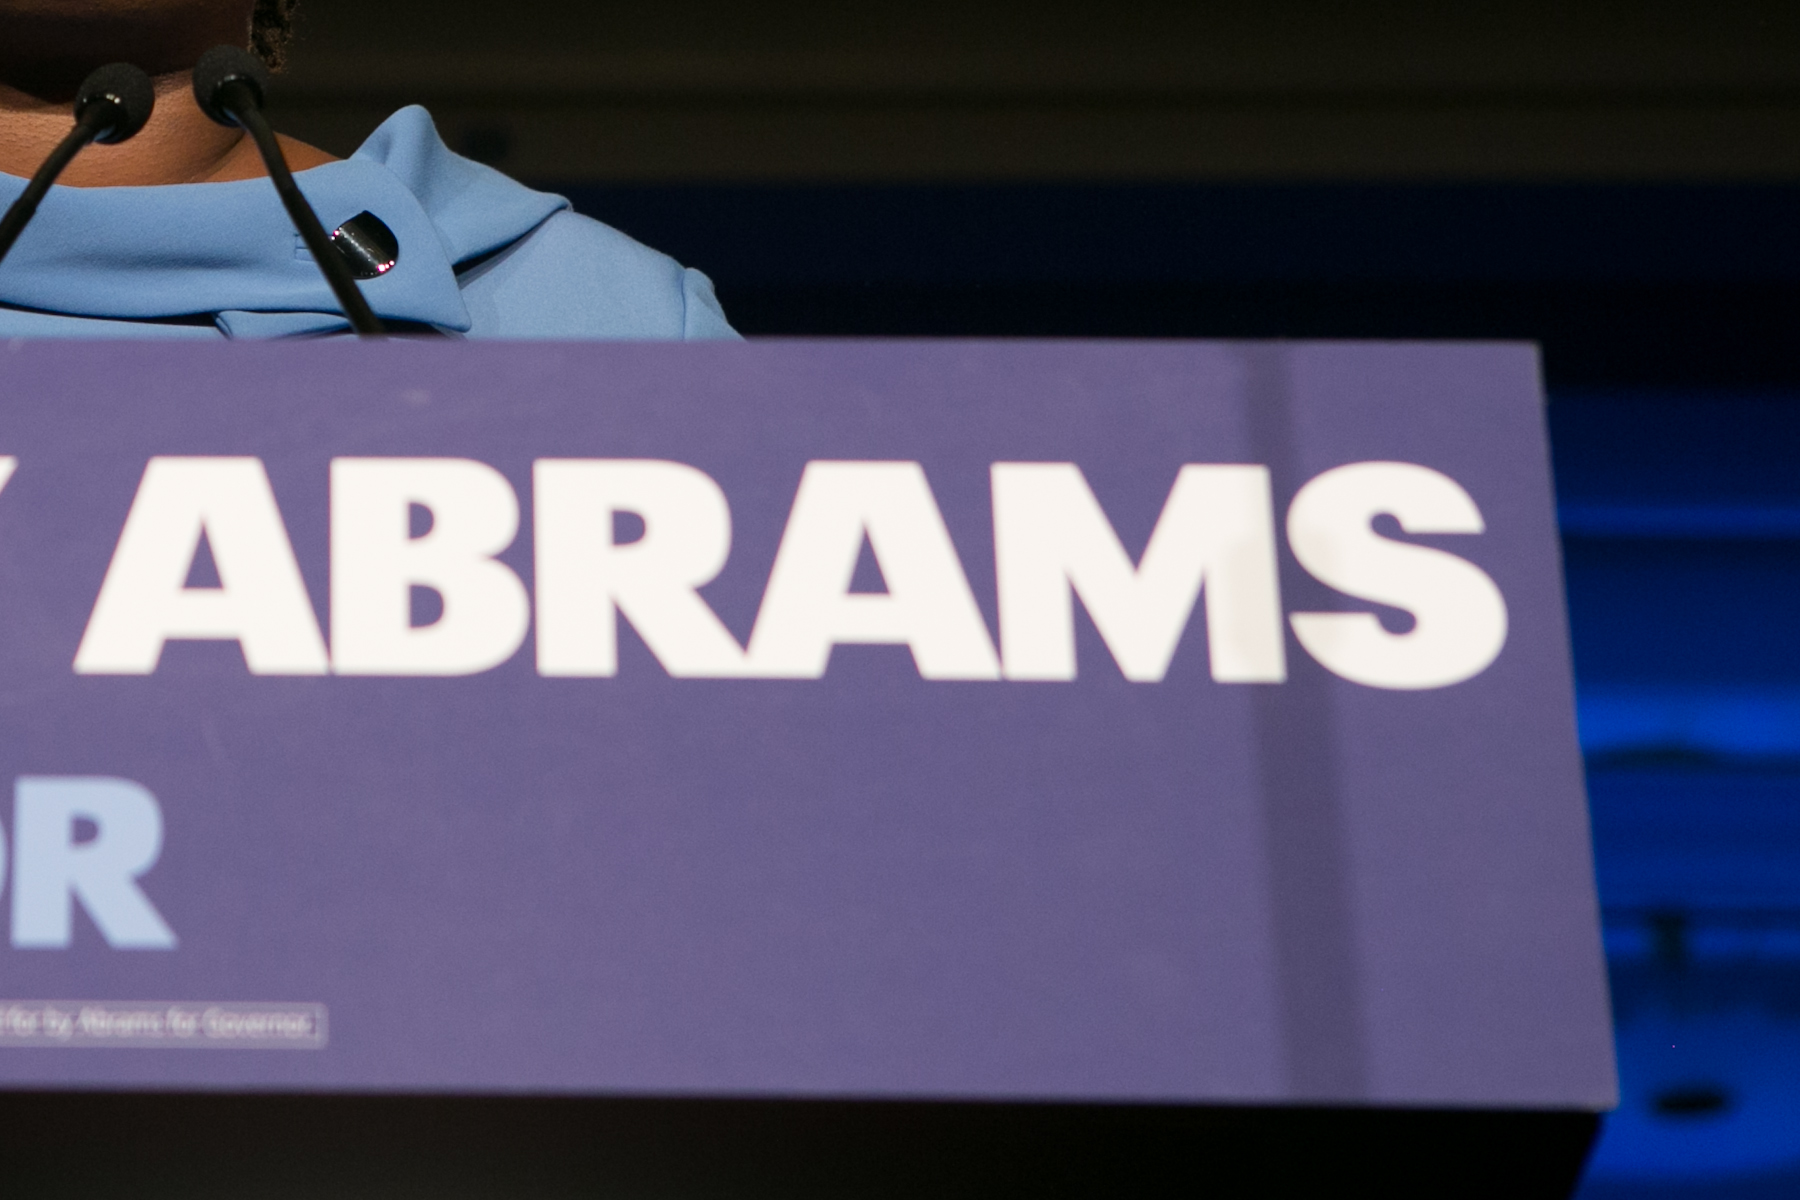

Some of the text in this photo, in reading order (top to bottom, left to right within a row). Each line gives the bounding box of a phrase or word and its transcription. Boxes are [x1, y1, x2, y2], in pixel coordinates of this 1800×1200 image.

[73, 456, 1509, 690] ABRAMS
[4, 1004, 38, 1037] for
[42, 1005, 73, 1042] by
[75, 1005, 163, 1038] Abrams
[165, 1006, 198, 1038] for
